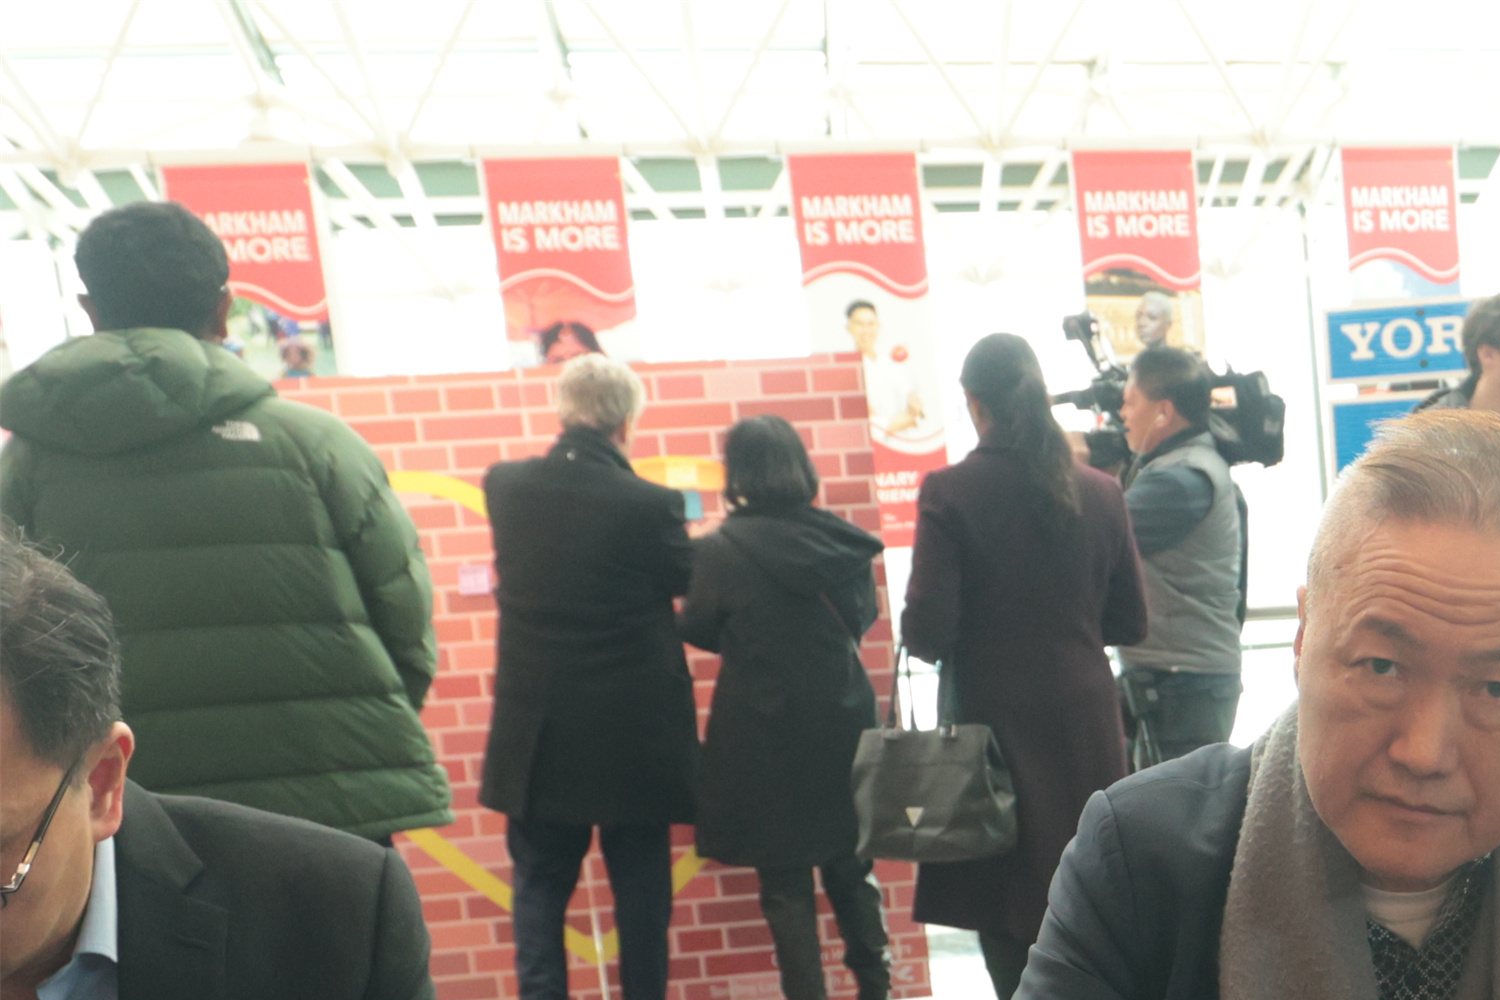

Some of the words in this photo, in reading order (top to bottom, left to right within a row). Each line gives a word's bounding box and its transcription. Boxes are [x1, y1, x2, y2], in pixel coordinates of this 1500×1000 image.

[800, 193, 914, 219] MARKHAM
[1084, 189, 1190, 213] MARKHAM
[1350, 185, 1449, 208] MARKHAM
[203, 209, 307, 236] ARKHAM
[497, 199, 617, 225] MARKHAM
[1353, 209, 1375, 233] IS
[1379, 207, 1450, 232] MORE
[501, 226, 529, 253] IS
[533, 224, 621, 252] MORE
[804, 220, 830, 246] IS
[834, 218, 917, 245] MORE
[1086, 214, 1110, 239] IS
[1115, 213, 1192, 239] MORE
[1340, 316, 1466, 361] YOR
